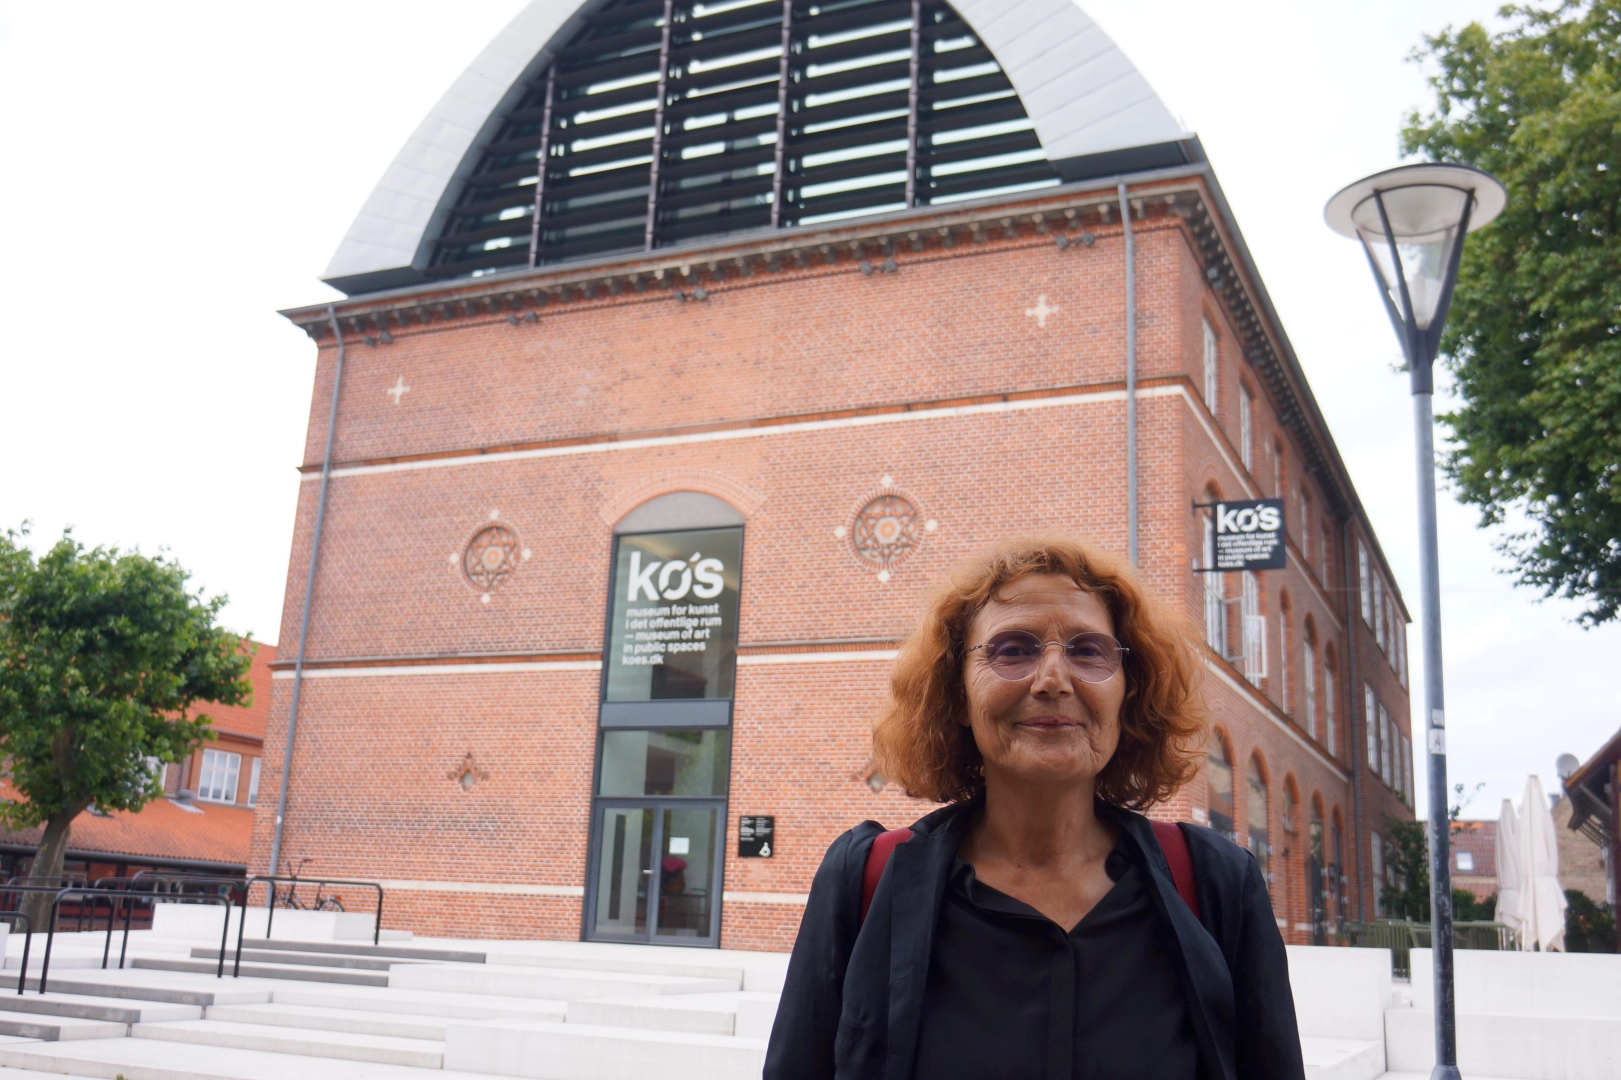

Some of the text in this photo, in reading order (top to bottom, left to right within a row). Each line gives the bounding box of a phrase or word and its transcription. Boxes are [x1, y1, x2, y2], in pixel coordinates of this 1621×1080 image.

[626, 603, 719, 618] museum for kunst
[630, 618, 647, 628] det
[649, 616, 698, 630] offentlige
[700, 616, 722, 626] rum
[635, 630, 680, 641] museum
[681, 628, 693, 639] of
[694, 628, 710, 639] art
[623, 642, 706, 655] in public spaces
[622, 654, 664, 665] koes.dk
